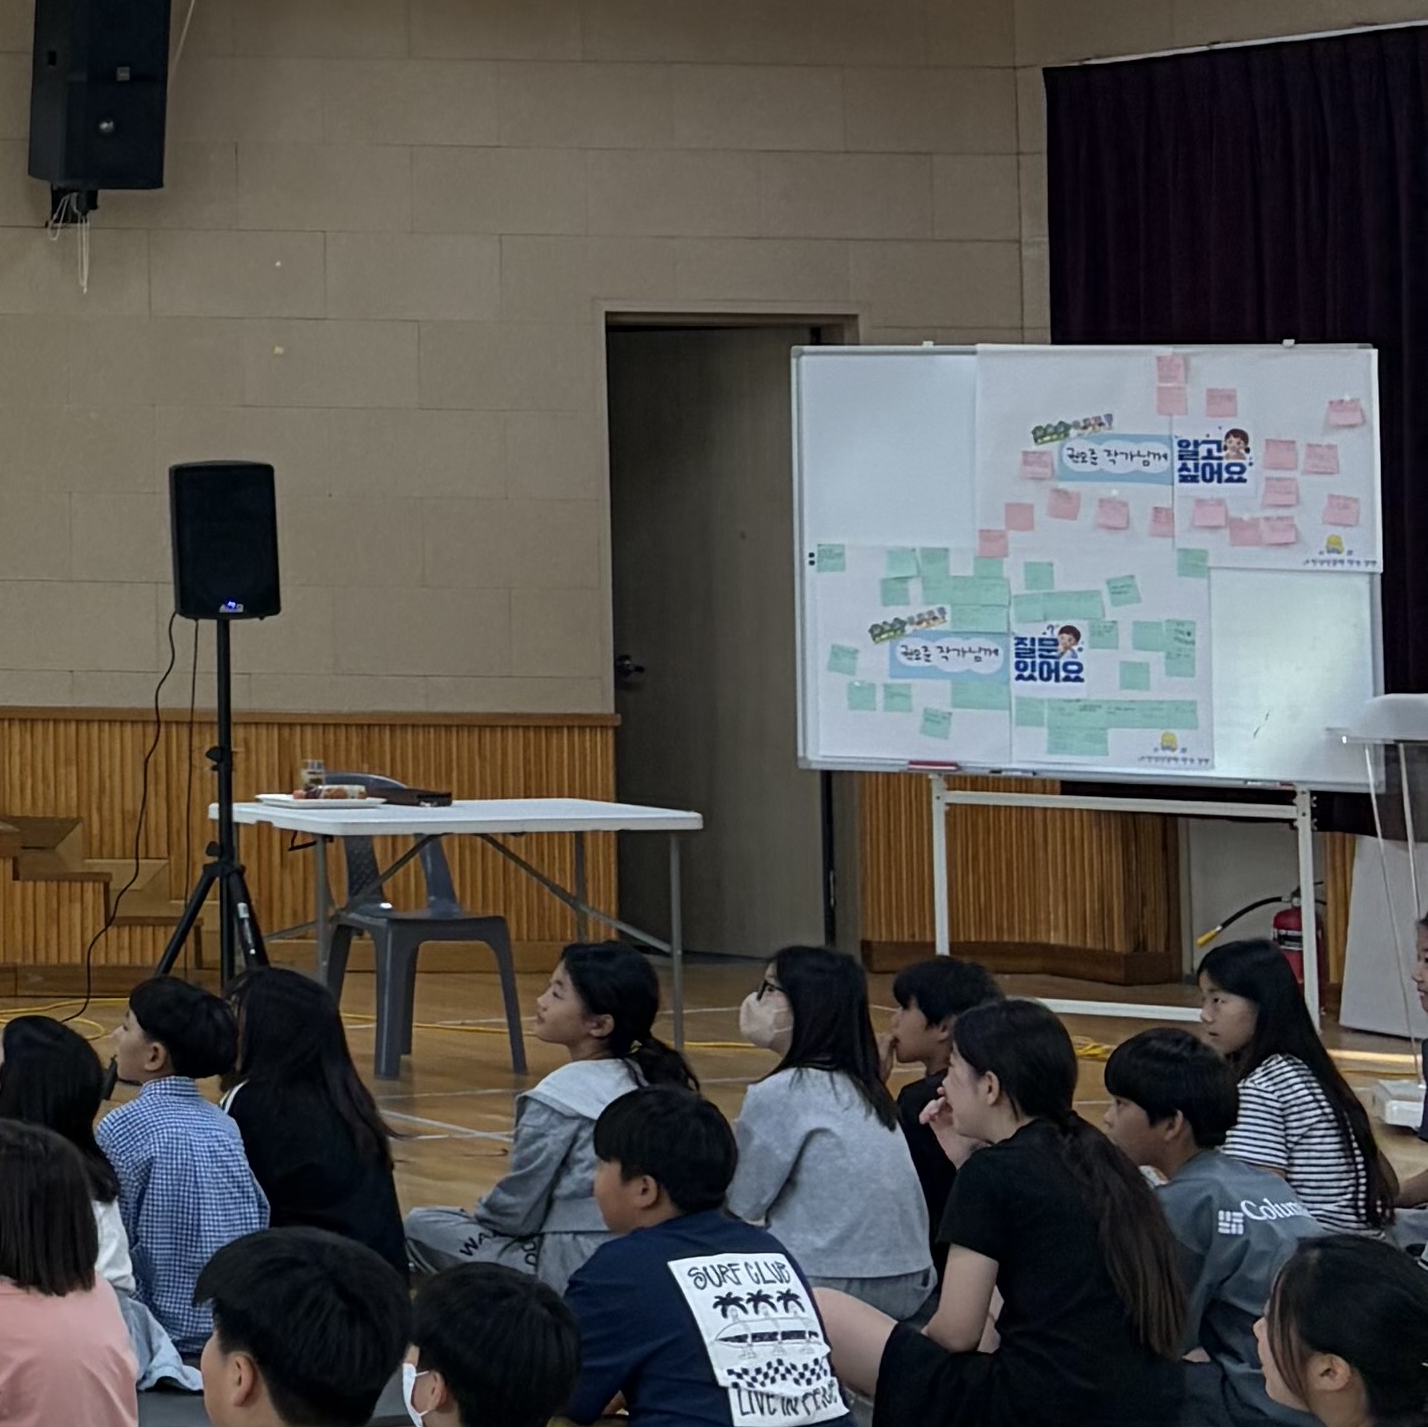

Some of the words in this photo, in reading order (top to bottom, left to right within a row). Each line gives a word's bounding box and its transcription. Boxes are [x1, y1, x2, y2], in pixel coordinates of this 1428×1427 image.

[1066, 447, 1098, 466] 권오준
[1177, 438, 1223, 461] 알고
[1177, 461, 1248, 484] 싶어요
[900, 644, 932, 663] 권오준
[1013, 636, 1060, 660] 질문
[1014, 660, 1085, 683] 있어요
[687, 1261, 742, 1290] SURF
[744, 1260, 792, 1285] CLUB
